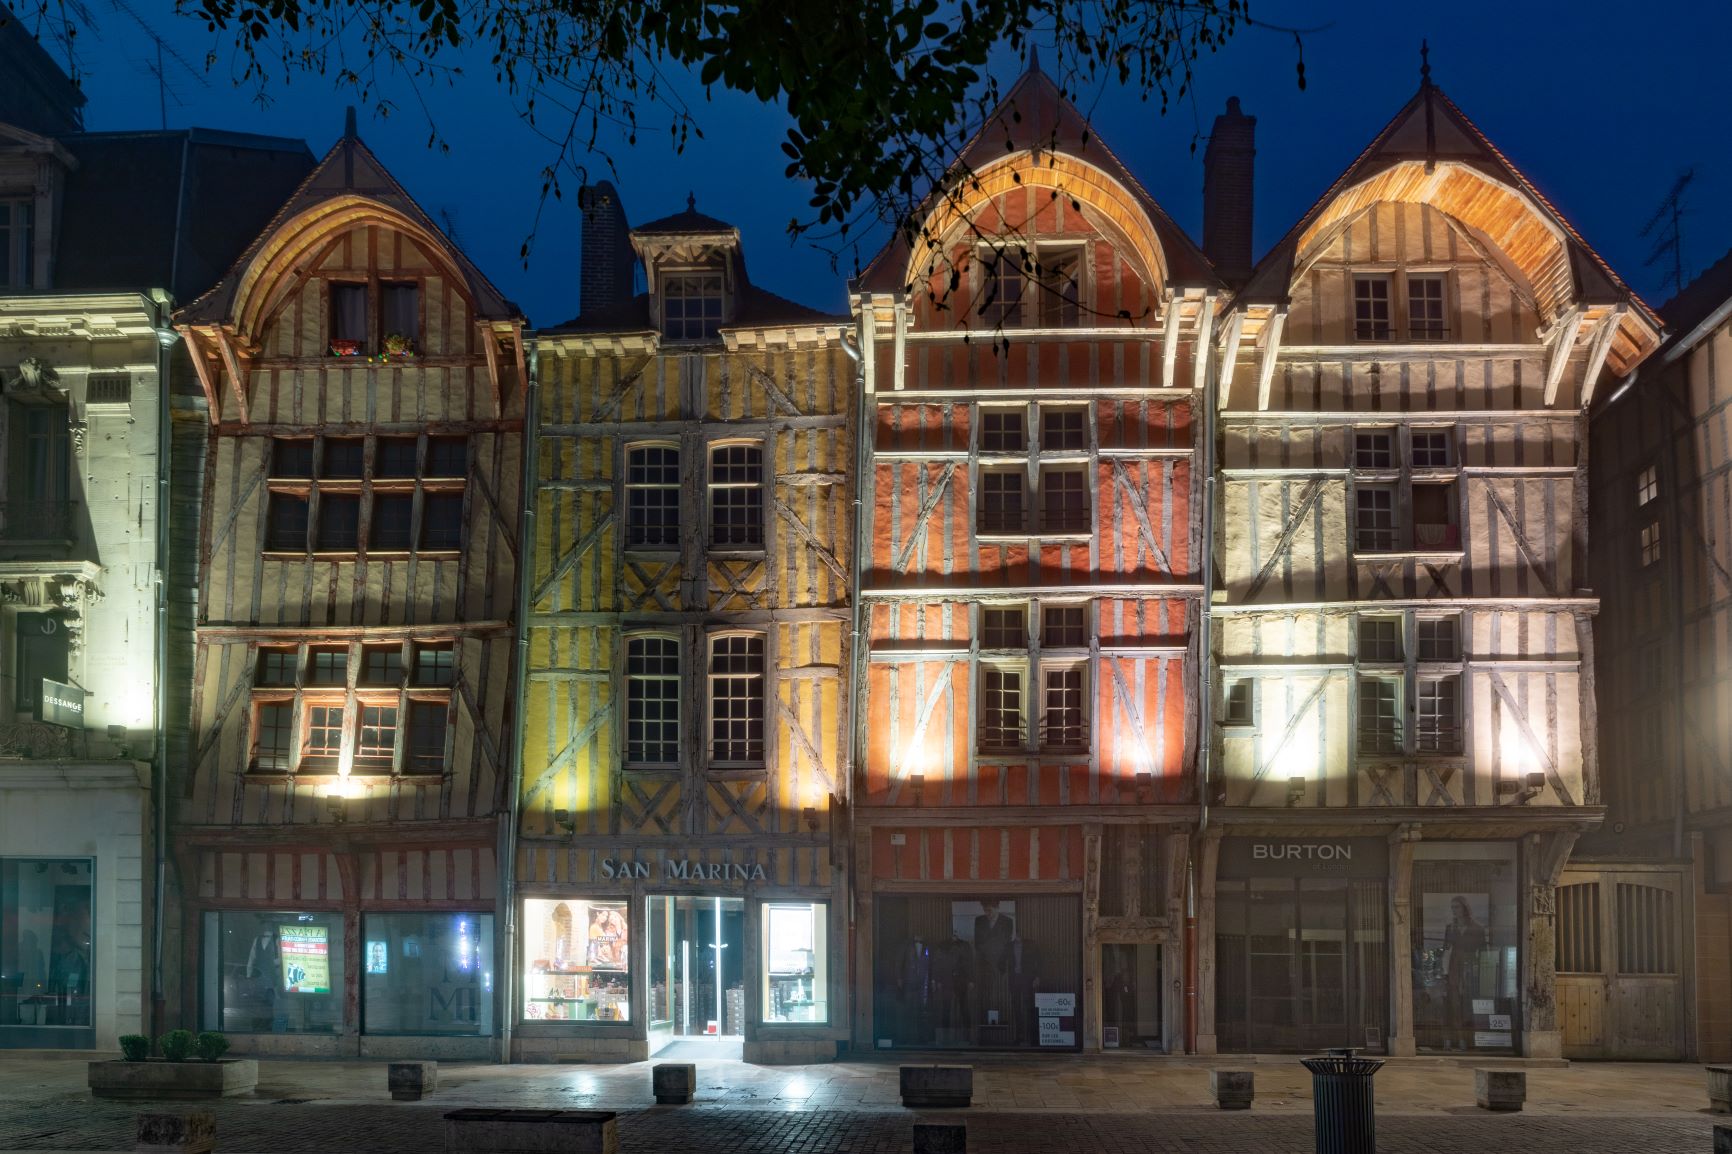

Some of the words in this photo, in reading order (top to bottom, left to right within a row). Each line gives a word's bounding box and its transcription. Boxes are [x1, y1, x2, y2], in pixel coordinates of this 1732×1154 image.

[44, 695, 82, 711] DESSANGE
[1252, 844, 1352, 860] BURTON
[601, 857, 651, 879] SAN
[667, 859, 767, 880] MARINA
